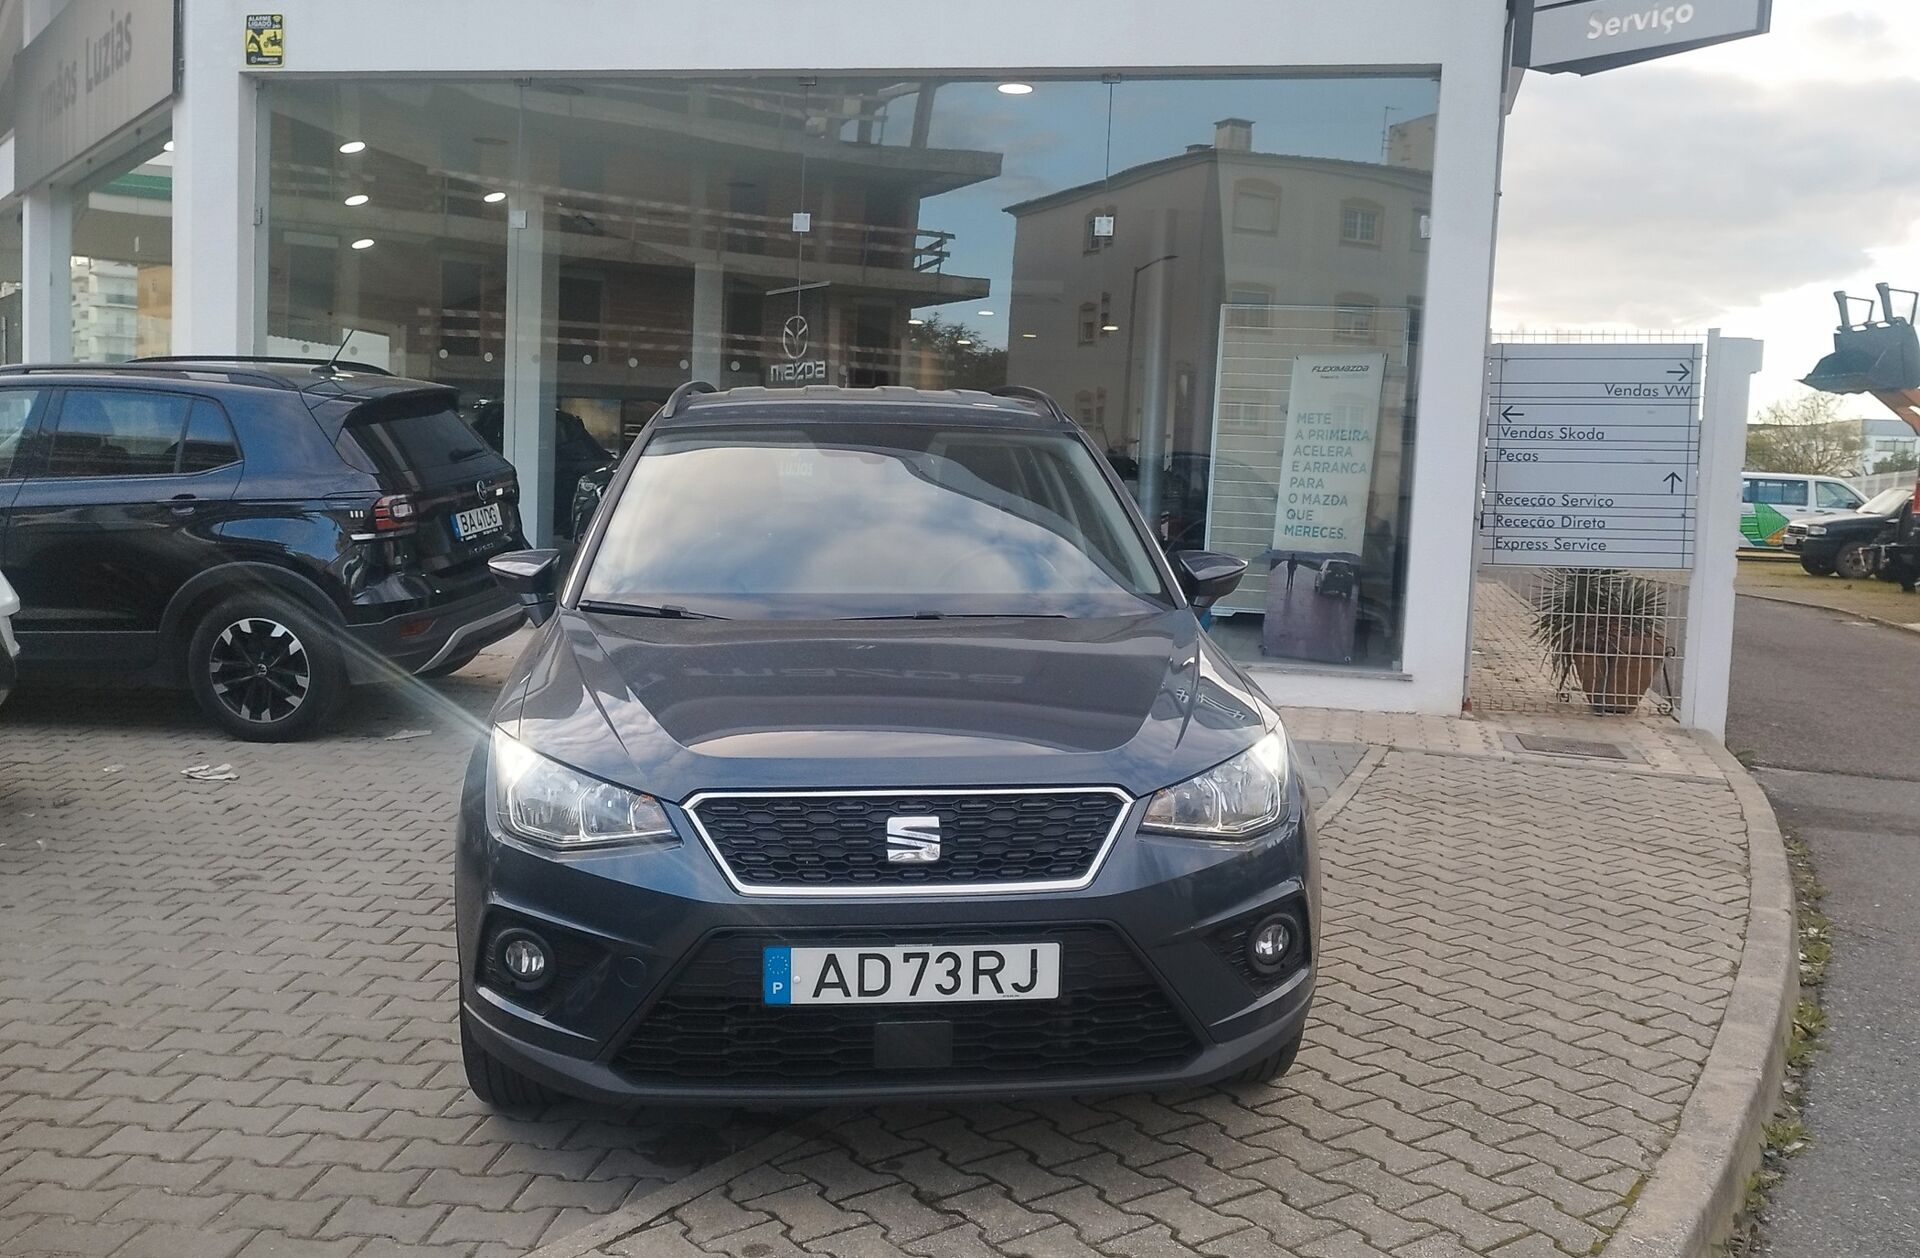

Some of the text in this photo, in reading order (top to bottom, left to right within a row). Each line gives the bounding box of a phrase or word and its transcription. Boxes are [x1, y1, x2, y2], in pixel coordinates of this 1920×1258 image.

[1586, 3, 1695, 40] Serviço
[86, 9, 133, 94] Luzias
[1604, 383, 1691, 397] Vendas VW
[1296, 412, 1332, 425] METE
[1294, 429, 1304, 441] A
[1500, 426, 1605, 441] Vendas Skoda
[1293, 445, 1353, 457] ACELERA
[1291, 460, 1368, 474] E ARRANCA
[1289, 476, 1325, 489] PARA
[1288, 492, 1349, 507] O MAZDA
[1496, 492, 1614, 509] Receção Serviço
[1286, 508, 1315, 521] QUE
[1496, 514, 1606, 529] Receção Direta
[1284, 524, 1347, 540] MERECES.
[1495, 537, 1607, 552] Express Service
[772, 981, 784, 995] P
